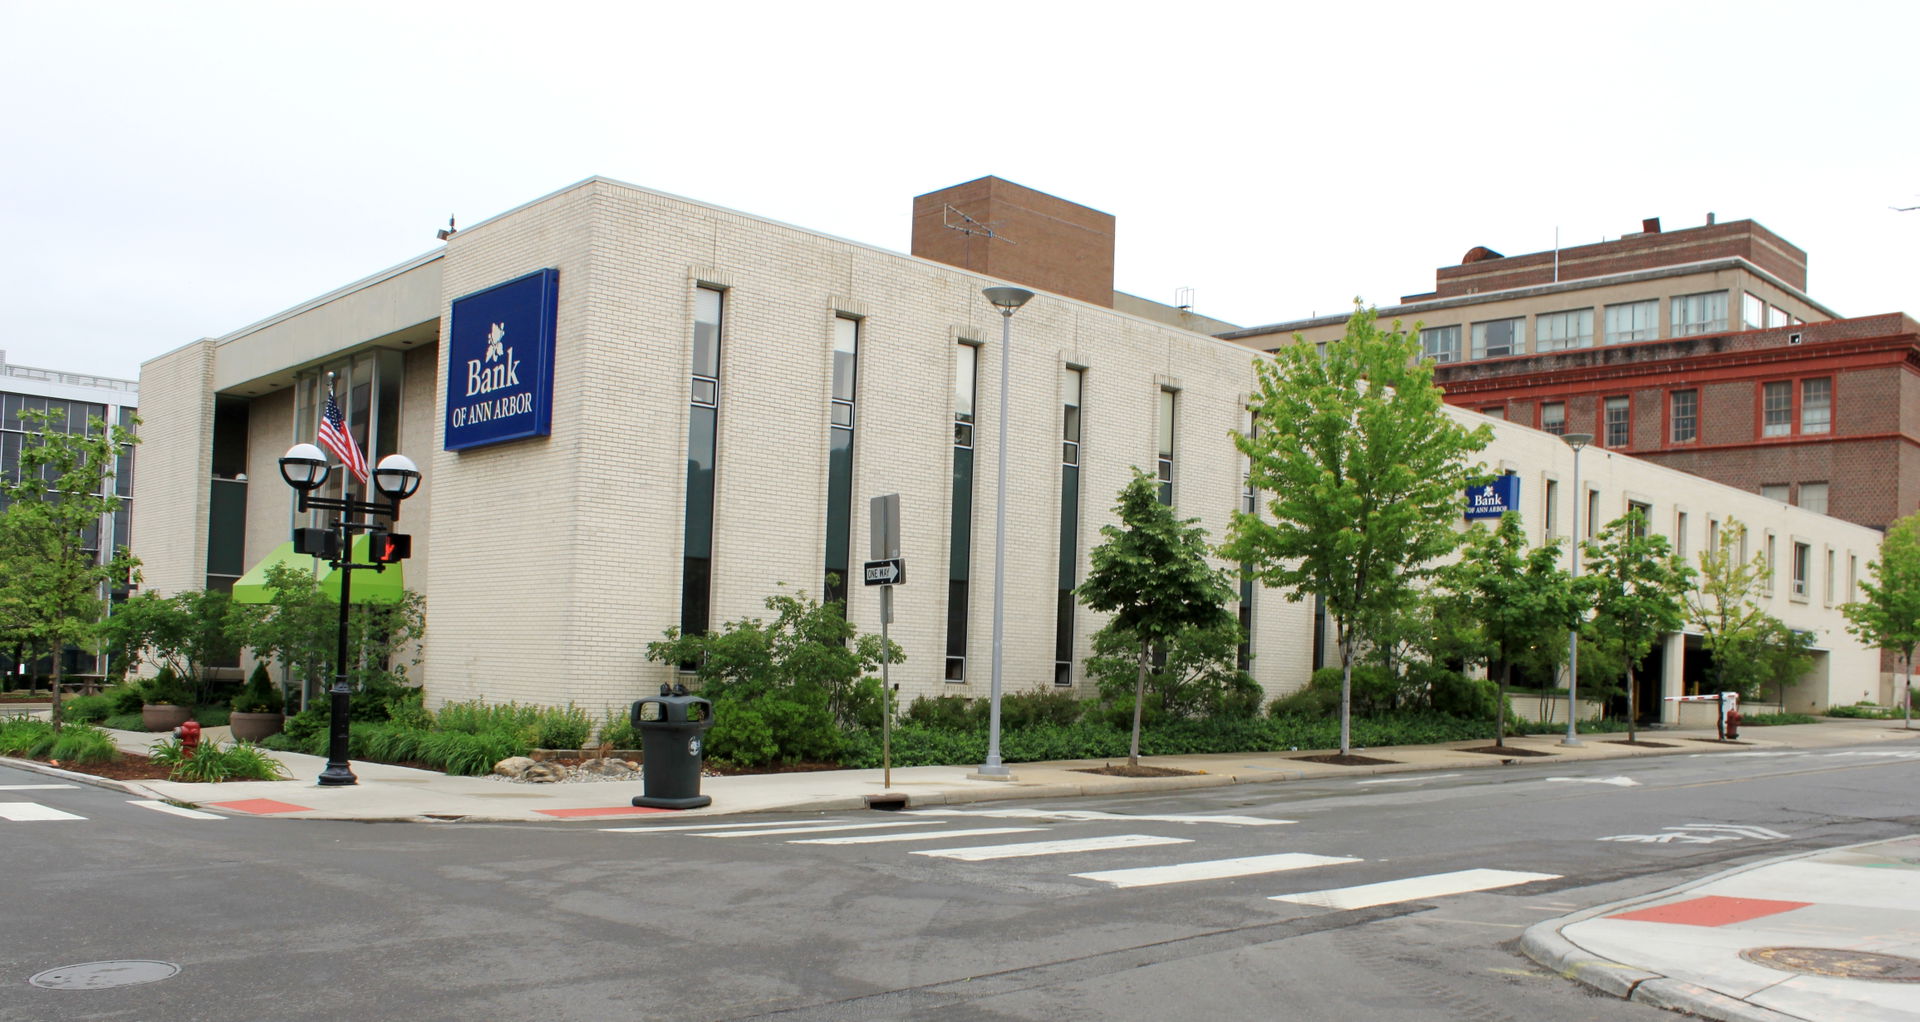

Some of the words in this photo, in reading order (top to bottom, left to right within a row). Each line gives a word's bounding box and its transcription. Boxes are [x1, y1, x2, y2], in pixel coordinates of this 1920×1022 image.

[466, 347, 521, 397] Bank
[453, 407, 467, 428] OF
[468, 401, 493, 425] ANN
[493, 392, 533, 420] ARBOR
[1475, 493, 1502, 506] Bank
[868, 568, 878, 578] ONE
[879, 567, 890, 577] WAY
